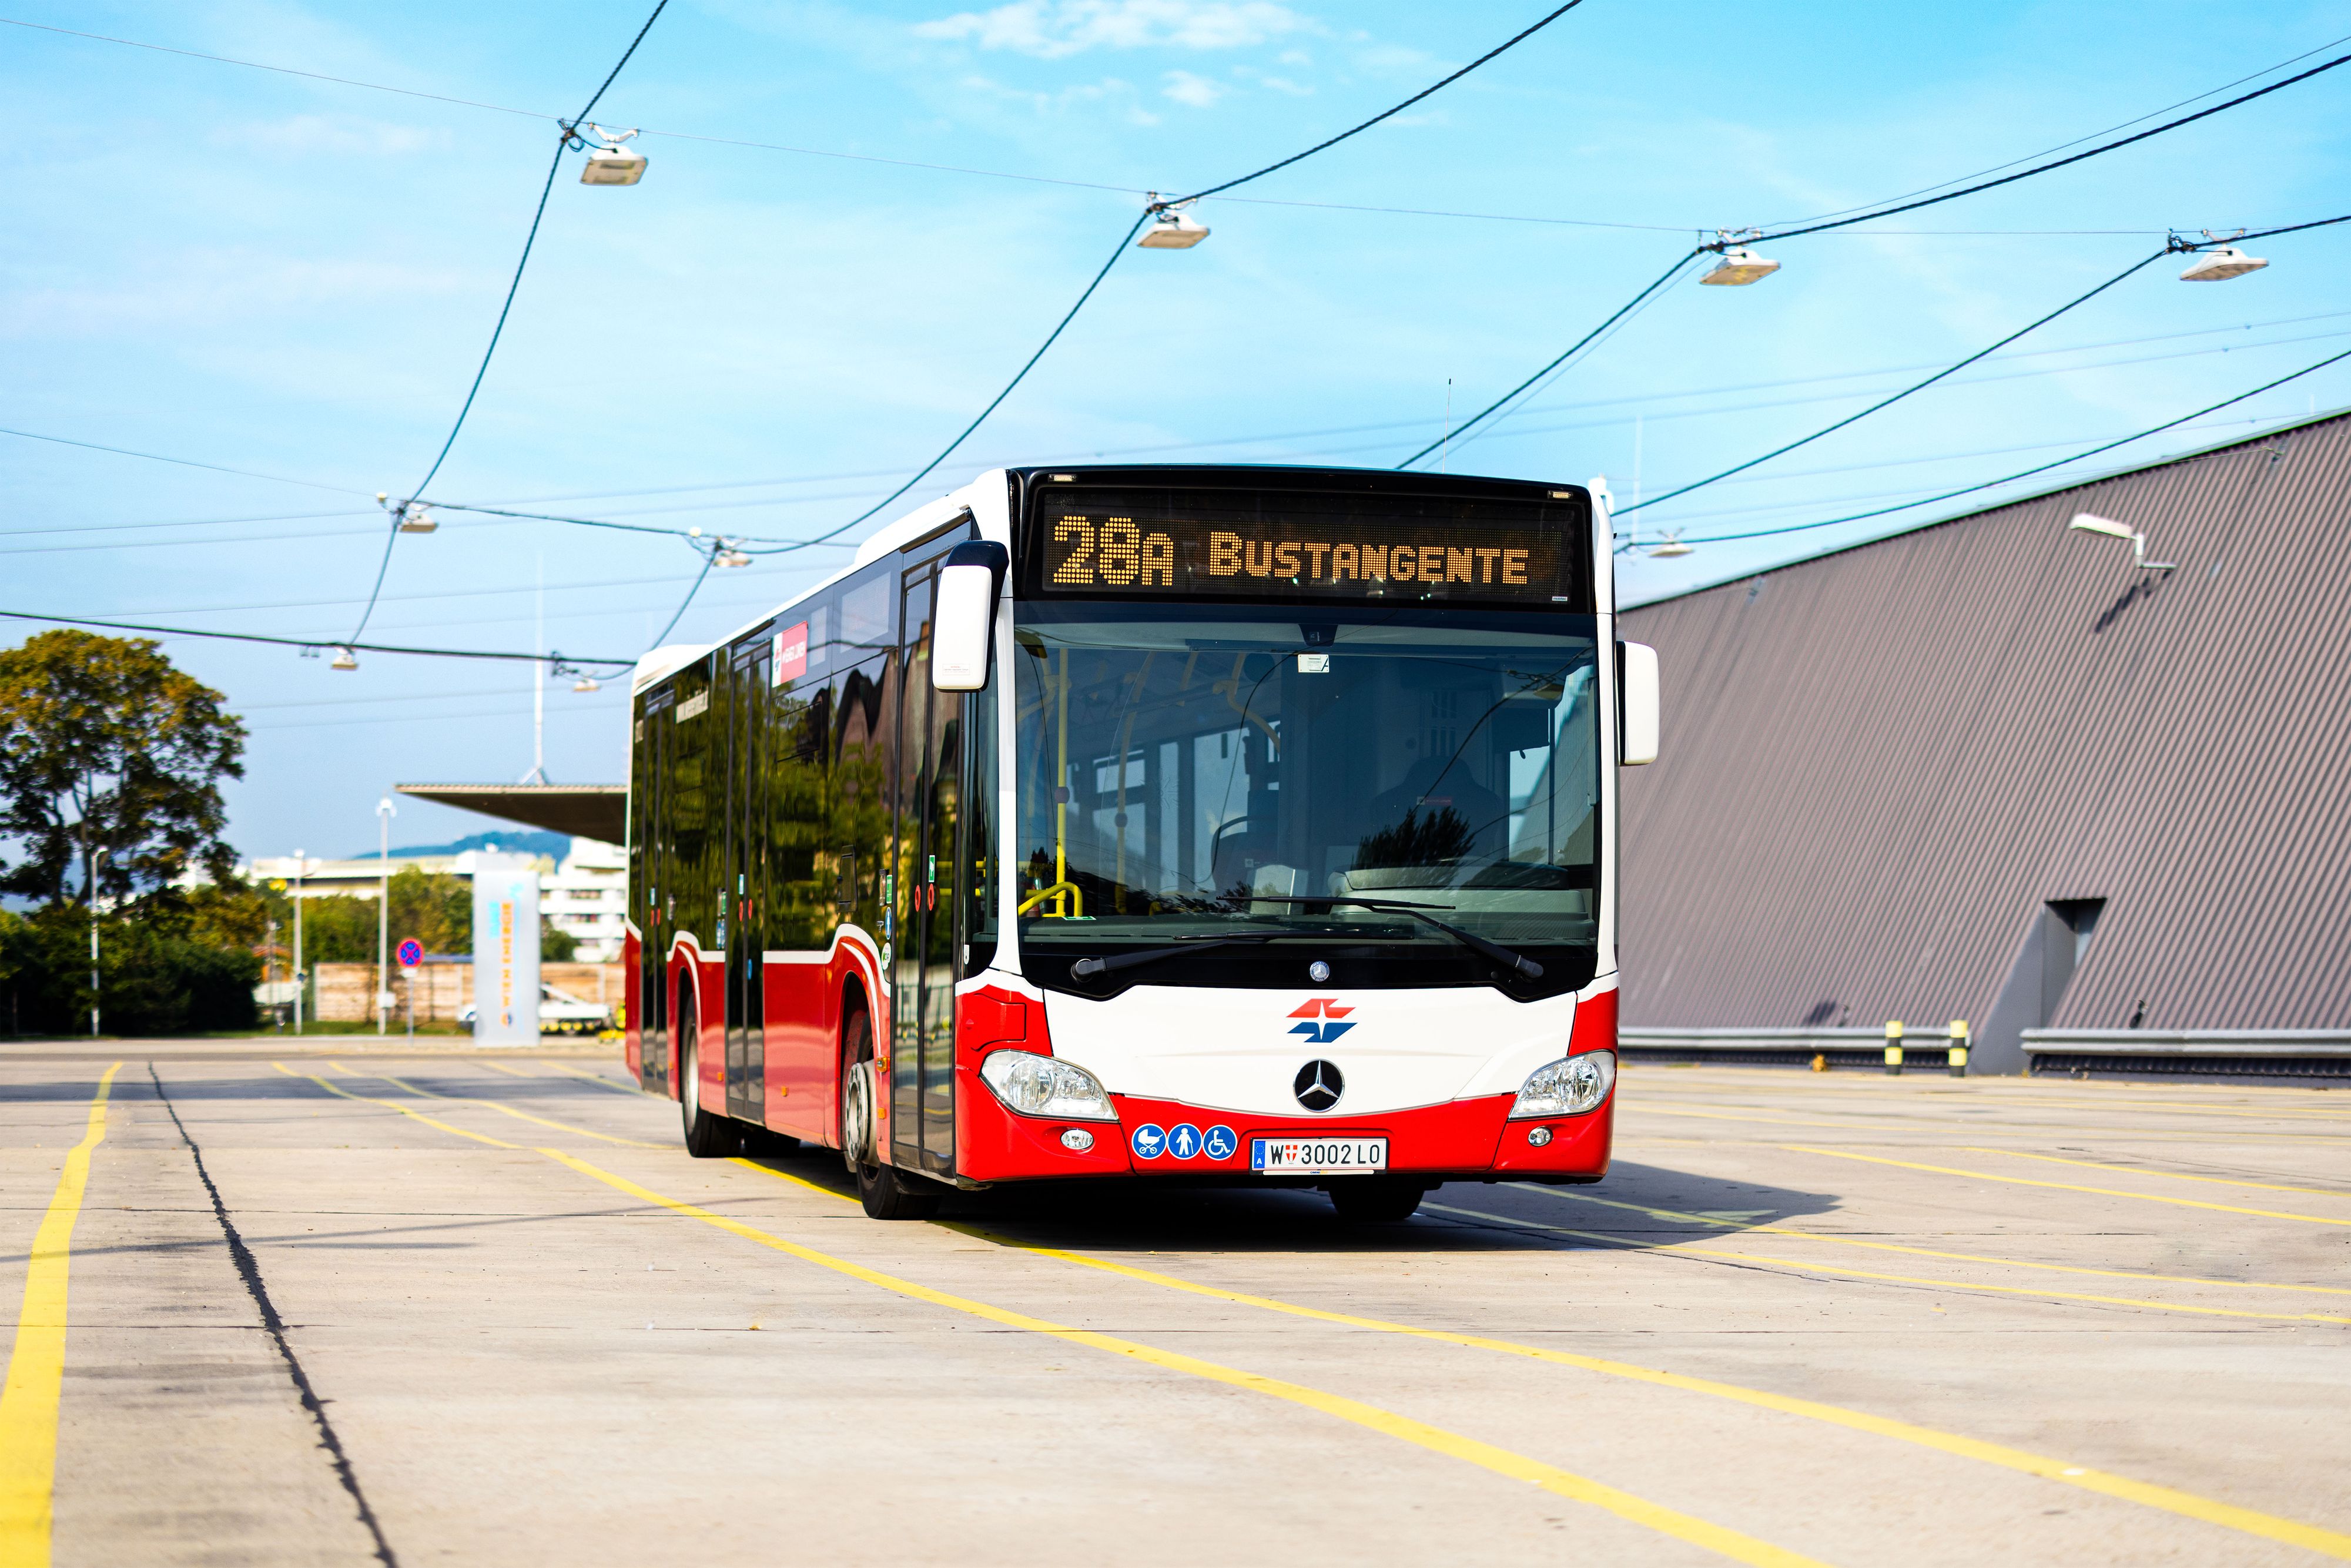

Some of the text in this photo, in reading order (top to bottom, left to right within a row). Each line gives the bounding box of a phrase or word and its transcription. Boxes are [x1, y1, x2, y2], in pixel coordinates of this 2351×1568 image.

[1053, 515, 1528, 586] 28A BUSTANGENTE
[1271, 1145, 1284, 1164] W
[1301, 1144, 1351, 1164] 3002
